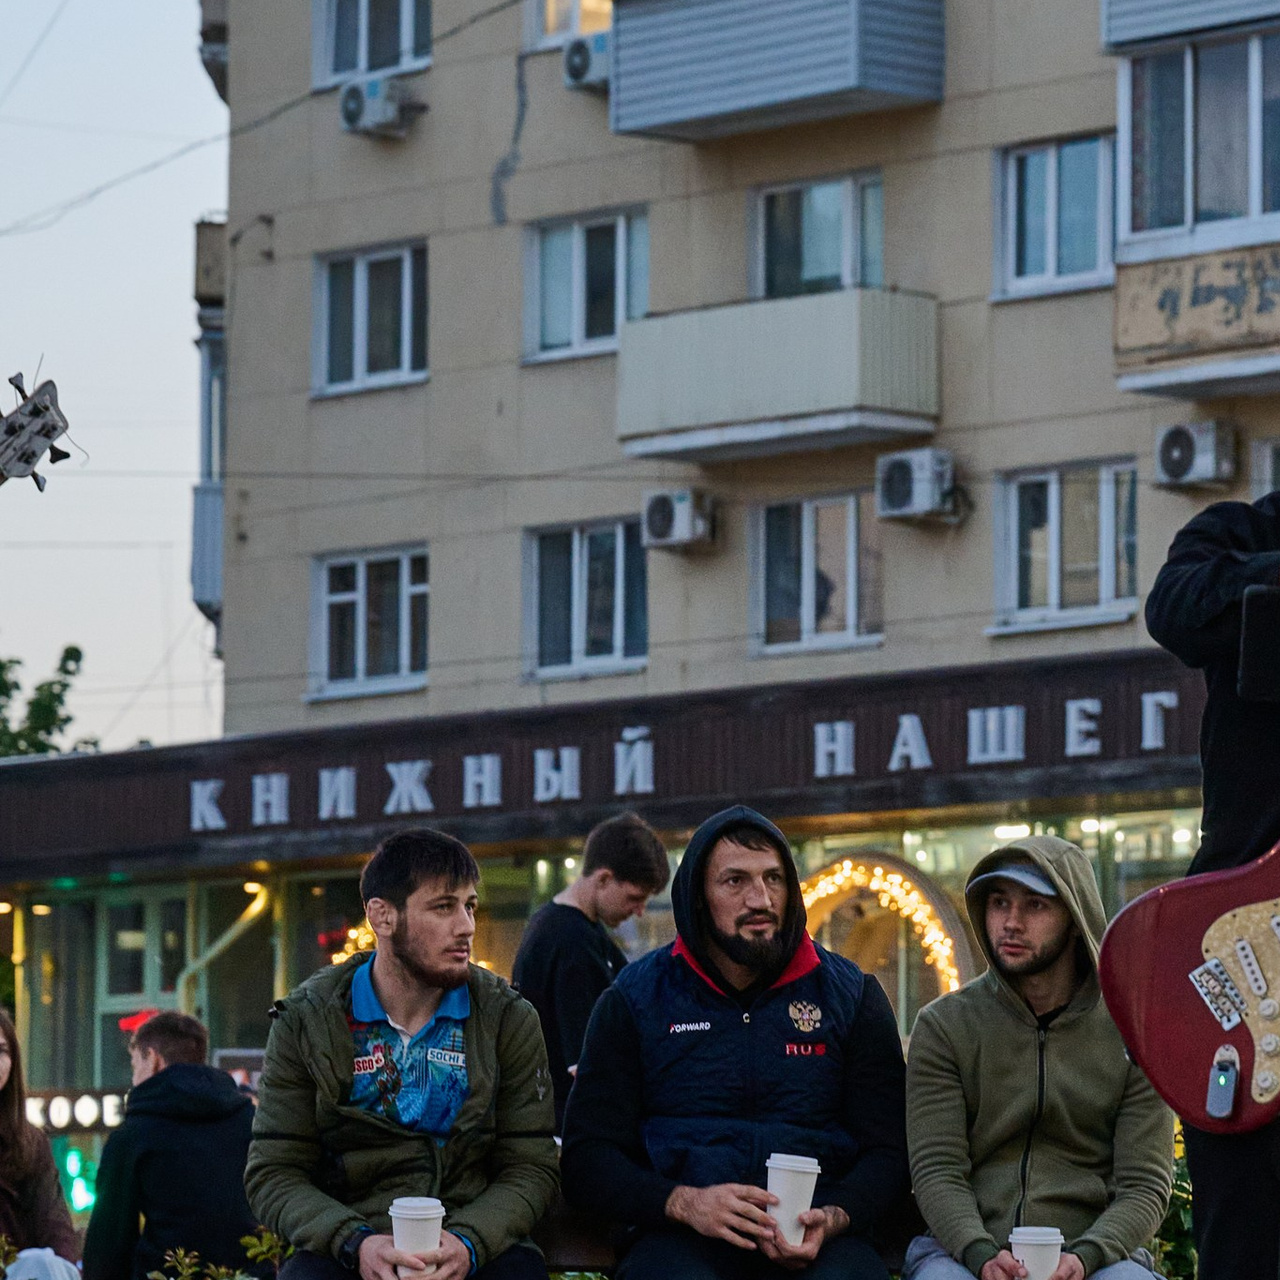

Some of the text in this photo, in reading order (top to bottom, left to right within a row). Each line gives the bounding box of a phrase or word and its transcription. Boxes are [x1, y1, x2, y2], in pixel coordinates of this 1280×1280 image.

[190, 725, 655, 832] КНИЖНЫЙ
[813, 691, 1179, 778] НАШЕГ
[669, 1022, 711, 1033] FORWARD
[785, 1043, 826, 1056] RUS
[430, 1050, 460, 1064] SOCHI
[354, 1058, 375, 1072] SCO
[24, 1090, 130, 1129] КОФЕ
